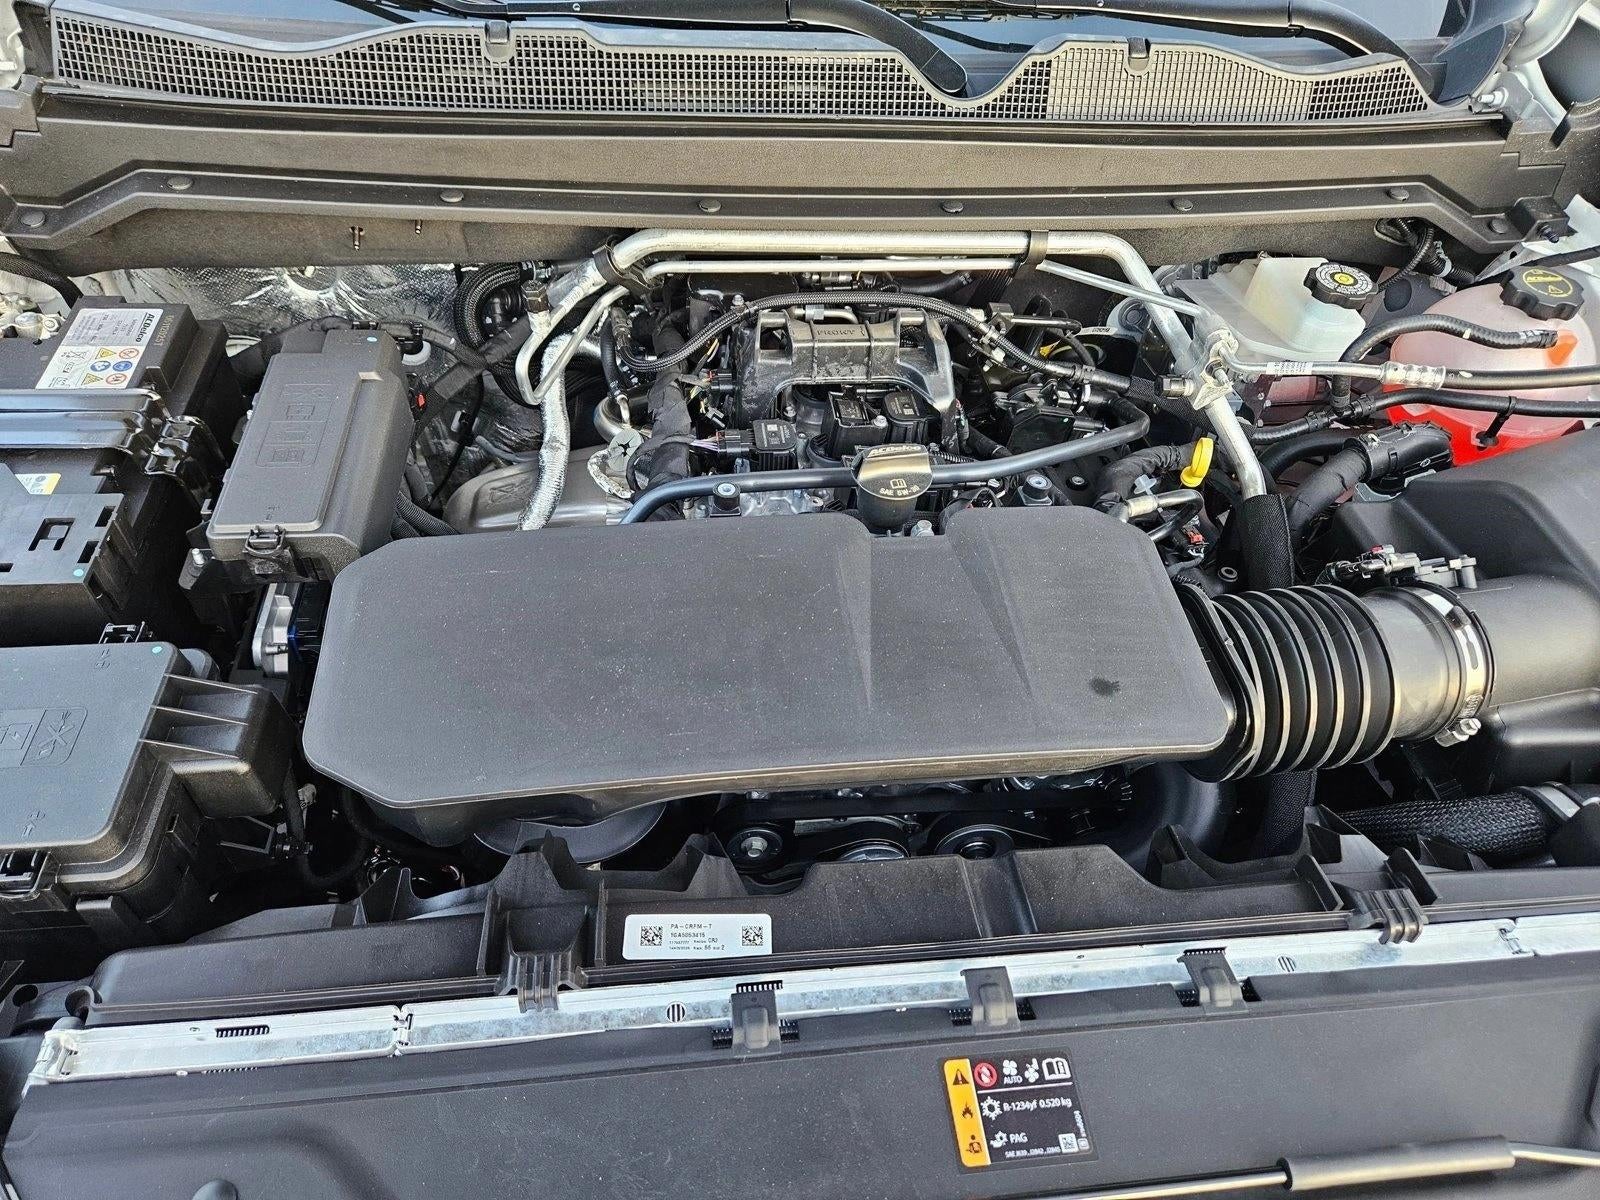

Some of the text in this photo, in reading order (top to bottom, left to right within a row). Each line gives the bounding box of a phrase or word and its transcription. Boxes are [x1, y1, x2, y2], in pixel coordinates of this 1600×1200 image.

[135, 313, 155, 342] ACDelco
[867, 445, 921, 458] ACDelco
[879, 487, 894, 496] SAE
[1003, 1075, 1023, 1085] AUTO
[1003, 1096, 1072, 1112] R-1234yf 0.520 kg
[1009, 1132, 1028, 1144] PAG
